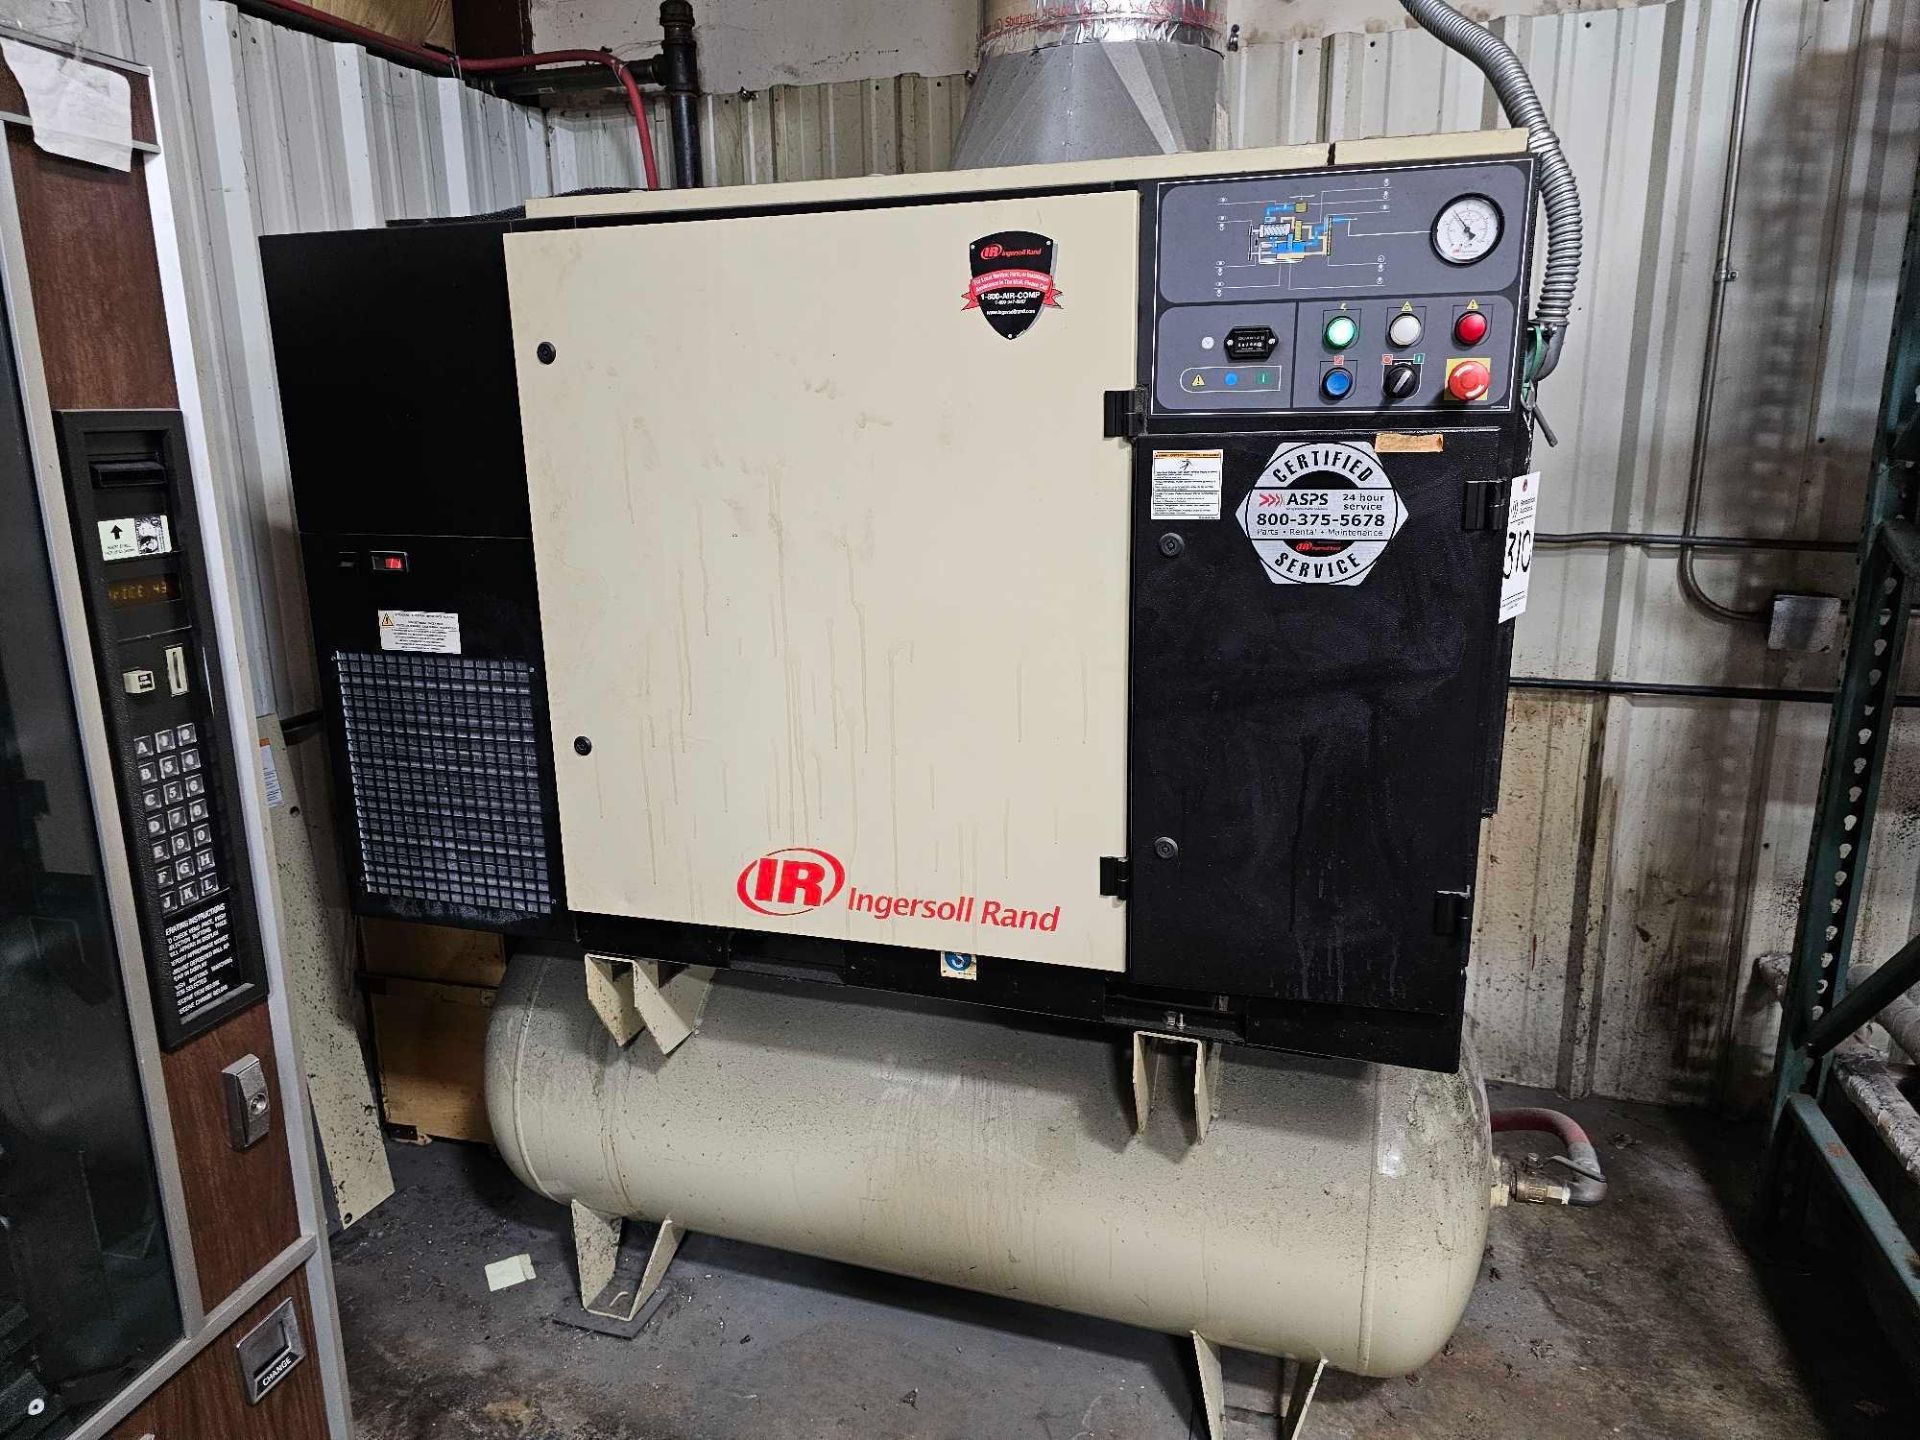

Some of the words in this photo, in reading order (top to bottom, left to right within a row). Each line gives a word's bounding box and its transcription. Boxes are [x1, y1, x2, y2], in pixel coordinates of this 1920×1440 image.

[980, 291, 1041, 300] 1-800-AIR-COMP
[1272, 450, 1373, 482] CERTIFIED
[1286, 493, 1328, 505] ASPS
[1343, 493, 1356, 501] 24
[1360, 493, 1385, 501] hour
[1343, 503, 1382, 511] service
[1257, 513, 1385, 526] 800-375-5678
[1329, 529, 1383, 537] Maintenance
[1275, 552, 1360, 578] SERVICE
[1503, 530, 1531, 579] 310
[137, 742, 148, 754] A
[161, 735, 168, 747] 1
[181, 729, 190, 740] 2
[141, 769, 151, 780] B
[164, 761, 173, 773] 3
[144, 794, 155, 806] C
[169, 787, 177, 798] 5
[190, 780, 198, 791] 6
[148, 820, 160, 833] D
[173, 812, 180, 824] 7
[193, 805, 202, 816] 8
[153, 846, 164, 858] E
[176, 838, 184, 849] 9
[158, 871, 167, 883] F
[180, 862, 190, 874] G
[200, 853, 210, 866] H
[163, 896, 170, 908] J
[184, 887, 193, 900] K
[205, 880, 213, 891] L
[752, 856, 827, 907] IR
[847, 887, 974, 922] Ingersoll
[980, 900, 1060, 932] Rand
[165, 921, 189, 936] ERATING
[188, 903, 225, 925] INSTRUCTIONS
[262, 1356, 292, 1386] CHANGE
